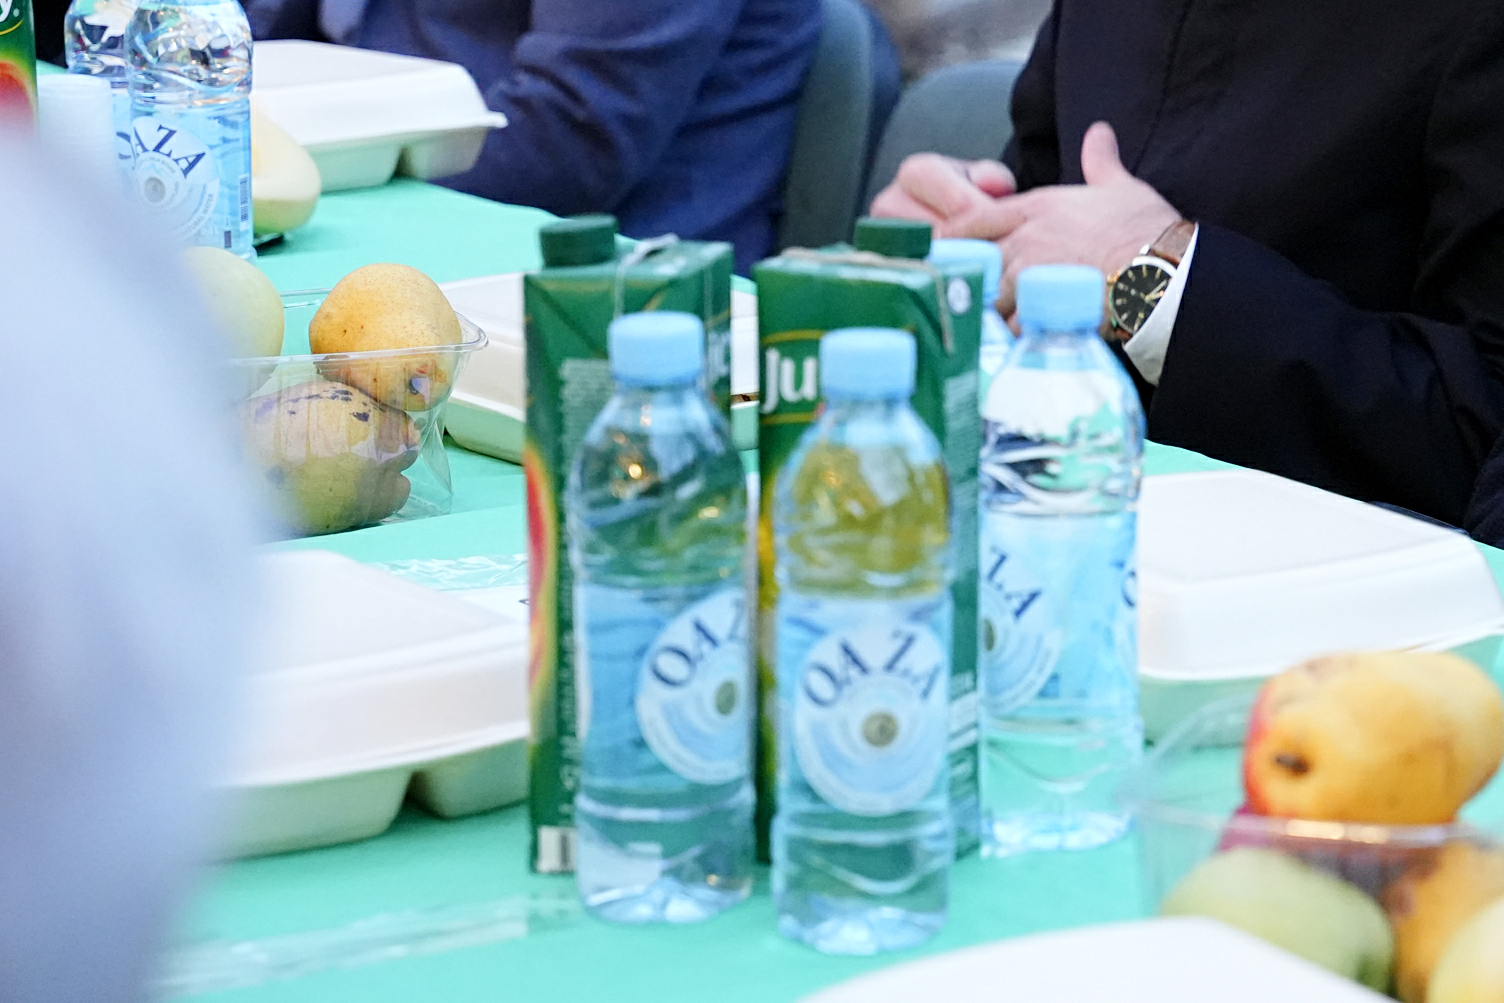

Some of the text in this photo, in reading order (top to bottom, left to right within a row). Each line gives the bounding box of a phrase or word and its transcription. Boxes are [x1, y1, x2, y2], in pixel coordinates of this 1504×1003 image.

[131, 124, 206, 180] AZA
[986, 545, 1042, 624] ZA
[652, 598, 748, 688] OA
